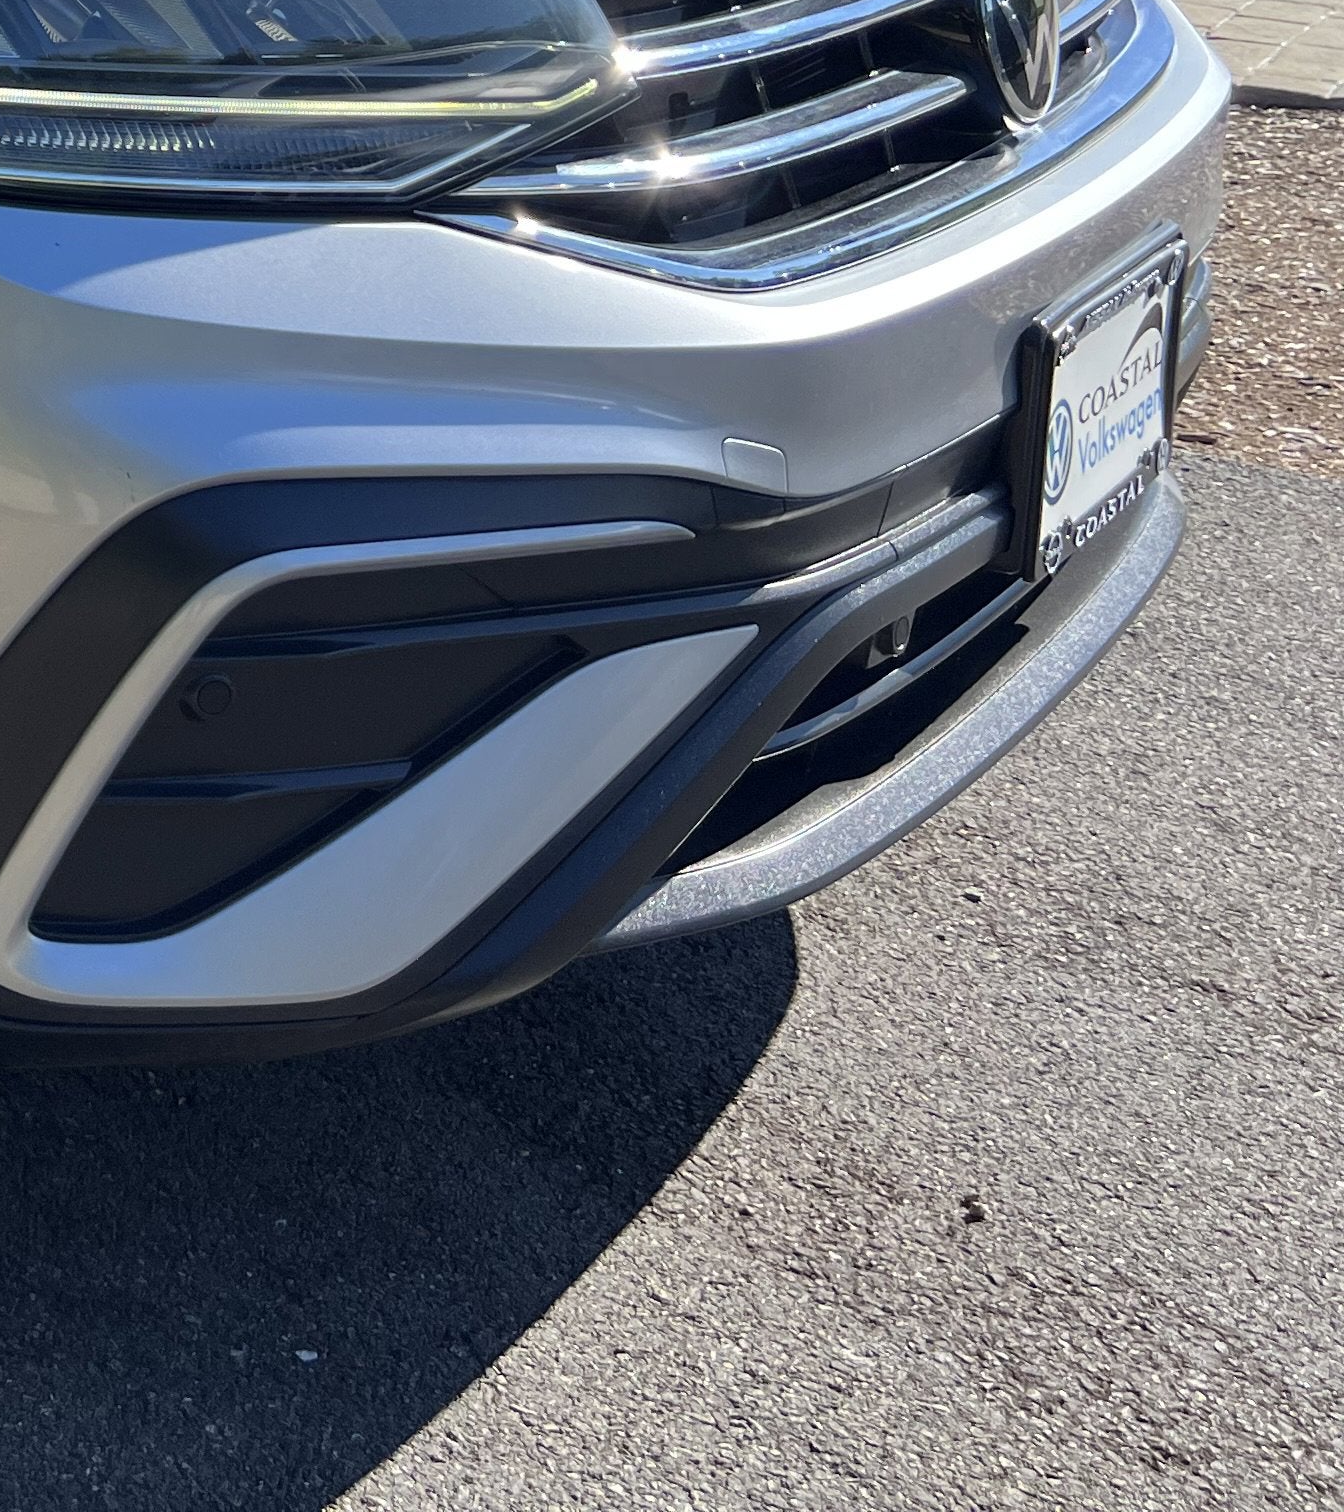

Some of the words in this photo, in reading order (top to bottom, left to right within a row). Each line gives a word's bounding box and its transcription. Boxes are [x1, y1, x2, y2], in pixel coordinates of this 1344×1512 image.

[1078, 341, 1162, 424] COASTAL
[1077, 387, 1162, 475] Volkswagen
[1074, 474, 1145, 548] COASTAL
